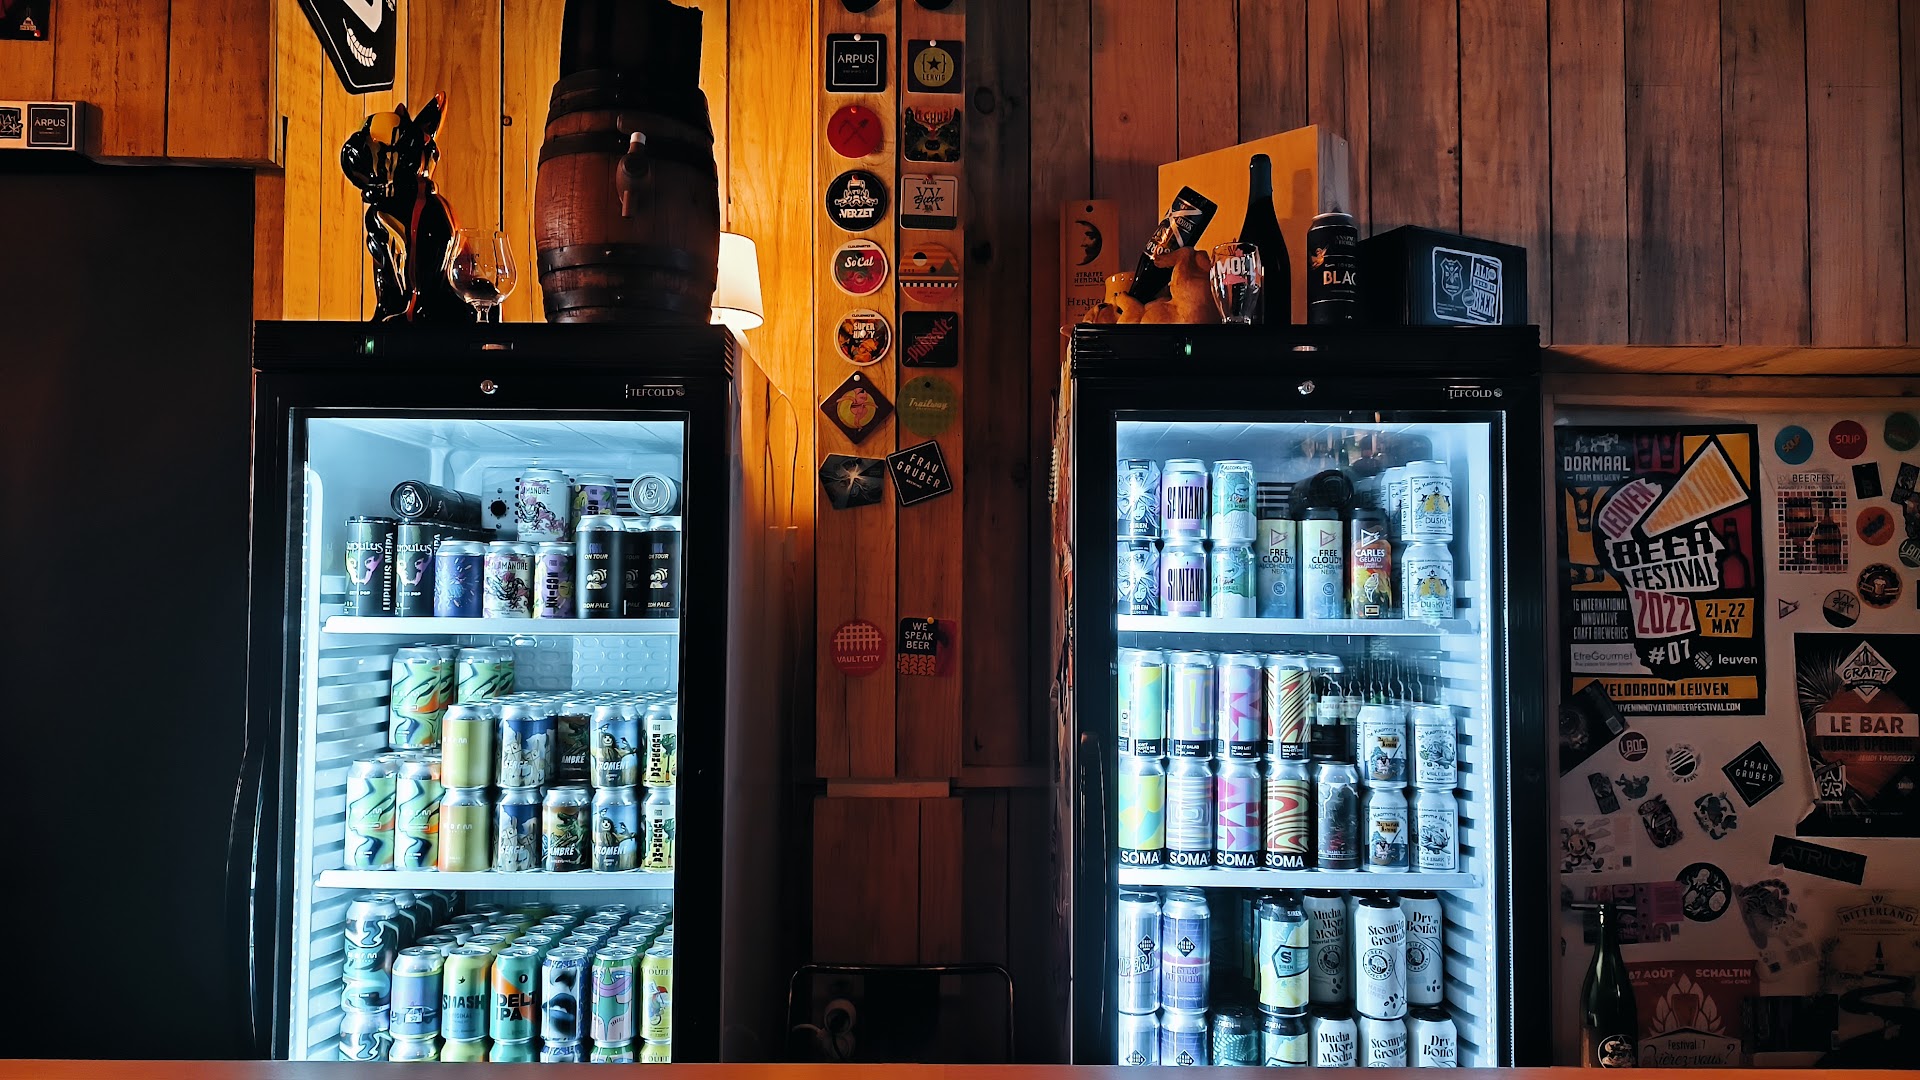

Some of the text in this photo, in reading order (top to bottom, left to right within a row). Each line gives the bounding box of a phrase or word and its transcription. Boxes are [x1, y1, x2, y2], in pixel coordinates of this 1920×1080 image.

[922, 73, 946, 81] LERVIG
[1472, 288, 1496, 317] BEER
[853, 322, 876, 331] SUPER
[852, 331, 876, 339] HAY
[630, 388, 675, 397] TEFCOLD
[1448, 388, 1492, 398] TEFCOLD
[909, 397, 949, 410] Trailway
[1782, 435, 1801, 453] SOUP
[1834, 433, 1861, 445] SOUP
[909, 453, 940, 474] FRAU
[1564, 455, 1631, 472] DORMAAL
[896, 460, 942, 489] GRUBER
[1792, 473, 1834, 483] BEERFEST
[1600, 480, 1655, 539] LEUVEN
[385, 533, 394, 563] NEIPA
[1269, 548, 1289, 556] FREE
[1319, 549, 1338, 557] FREE
[1354, 549, 1385, 557] CARLES
[1612, 528, 1714, 568] BEER
[1262, 555, 1294, 564] CLOUDY
[1311, 556, 1342, 564] CLOUDY
[1631, 556, 1717, 590] FESTIVAL
[1573, 597, 1628, 611] 16 INTERNATIONAL
[1634, 590, 1691, 634] 2022
[1705, 603, 1745, 618] 21-22
[1581, 612, 1618, 625] INNOVATIVE
[912, 622, 928, 631] WE
[1711, 619, 1740, 634] MAY
[904, 631, 934, 641] SPEAK
[1573, 626, 1629, 640] CRAFT BREWERIES
[905, 640, 930, 650] BEER
[1648, 639, 1690, 665] #07
[836, 655, 880, 663] VAULT CITY
[1718, 653, 1758, 665] leuven
[1843, 667, 1892, 682] CRAFT
[1604, 682, 1729, 697] VELODROOM LEUVEN
[1831, 716, 1904, 733] LE BAR
[561, 752, 586, 764] AMBRÉ
[1879, 755, 1915, 763] 19/05/2022
[503, 760, 528, 769] SERGE
[1743, 759, 1769, 771] FRAU
[1735, 768, 1774, 783] GRUBER
[1121, 850, 1160, 865] SOMA
[1169, 851, 1208, 866] SOMA
[1216, 852, 1256, 867] SOMA
[1265, 852, 1304, 868] SOMA
[1779, 845, 1857, 872] ATRIUM
[1313, 908, 1342, 920] Mucha
[1413, 911, 1433, 923] Dry
[1842, 907, 1914, 923] BITTERLAND
[1315, 927, 1345, 939] Mocha
[1406, 921, 1437, 934] Bones
[1643, 968, 1675, 979] AOÛT
[1695, 968, 1752, 978] SCHALTIN
[442, 994, 486, 1010] SMASH
[496, 1008, 523, 1021] IPA
[1320, 1031, 1350, 1042] Mucha
[1430, 1035, 1450, 1047] Dry
[1329, 1041, 1354, 1053] Mora
[1423, 1044, 1454, 1058] Bones
[1667, 1040, 1697, 1050] Festival
[1321, 1051, 1353, 1063] Mocha
